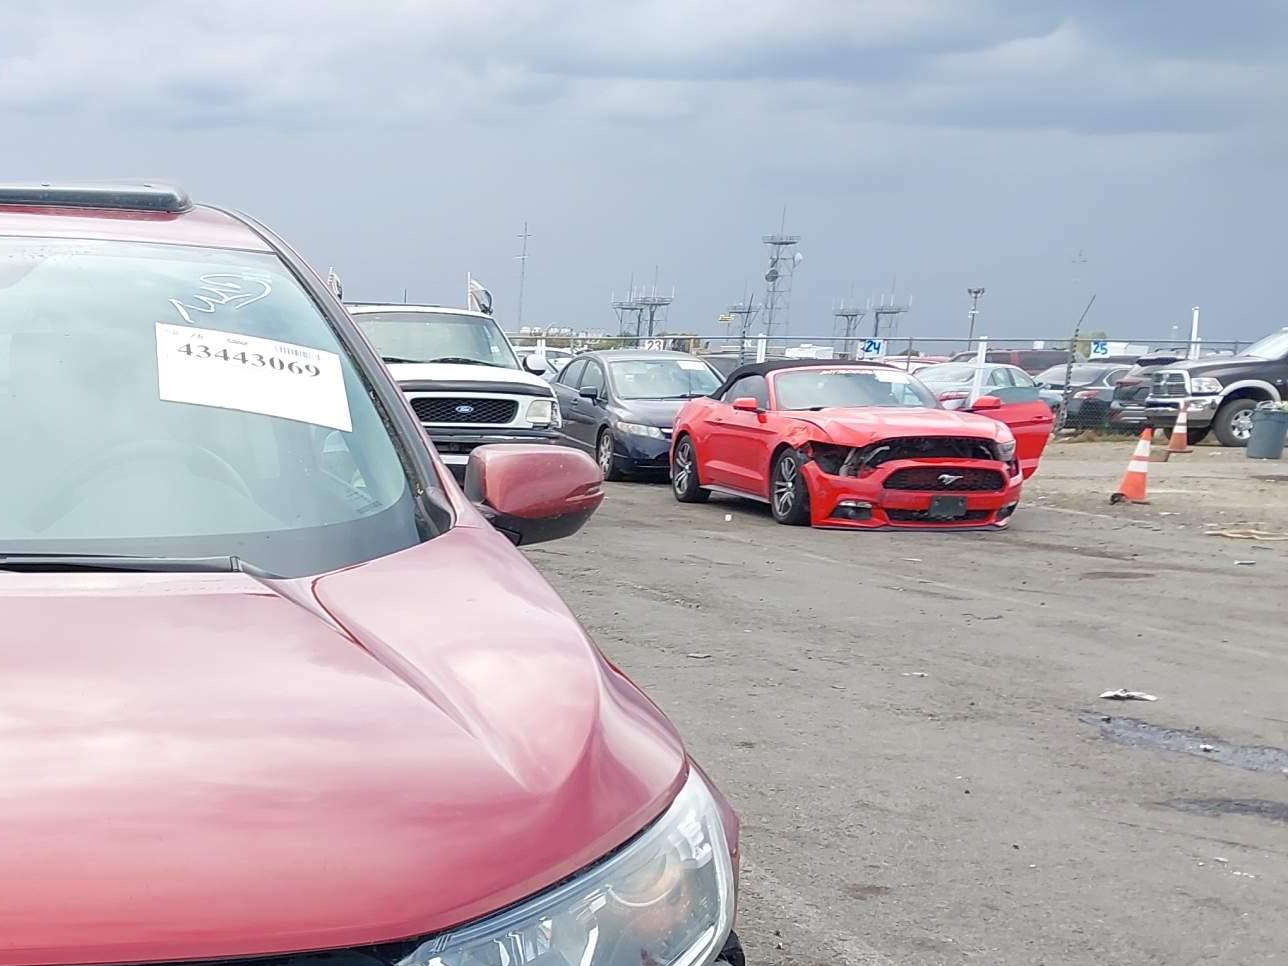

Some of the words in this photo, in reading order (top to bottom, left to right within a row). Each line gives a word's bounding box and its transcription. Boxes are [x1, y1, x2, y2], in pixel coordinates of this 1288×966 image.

[647, 340, 662, 351] 23
[864, 340, 881, 354] 24
[1093, 340, 1108, 355] 25
[176, 342, 321, 377] 43443069
